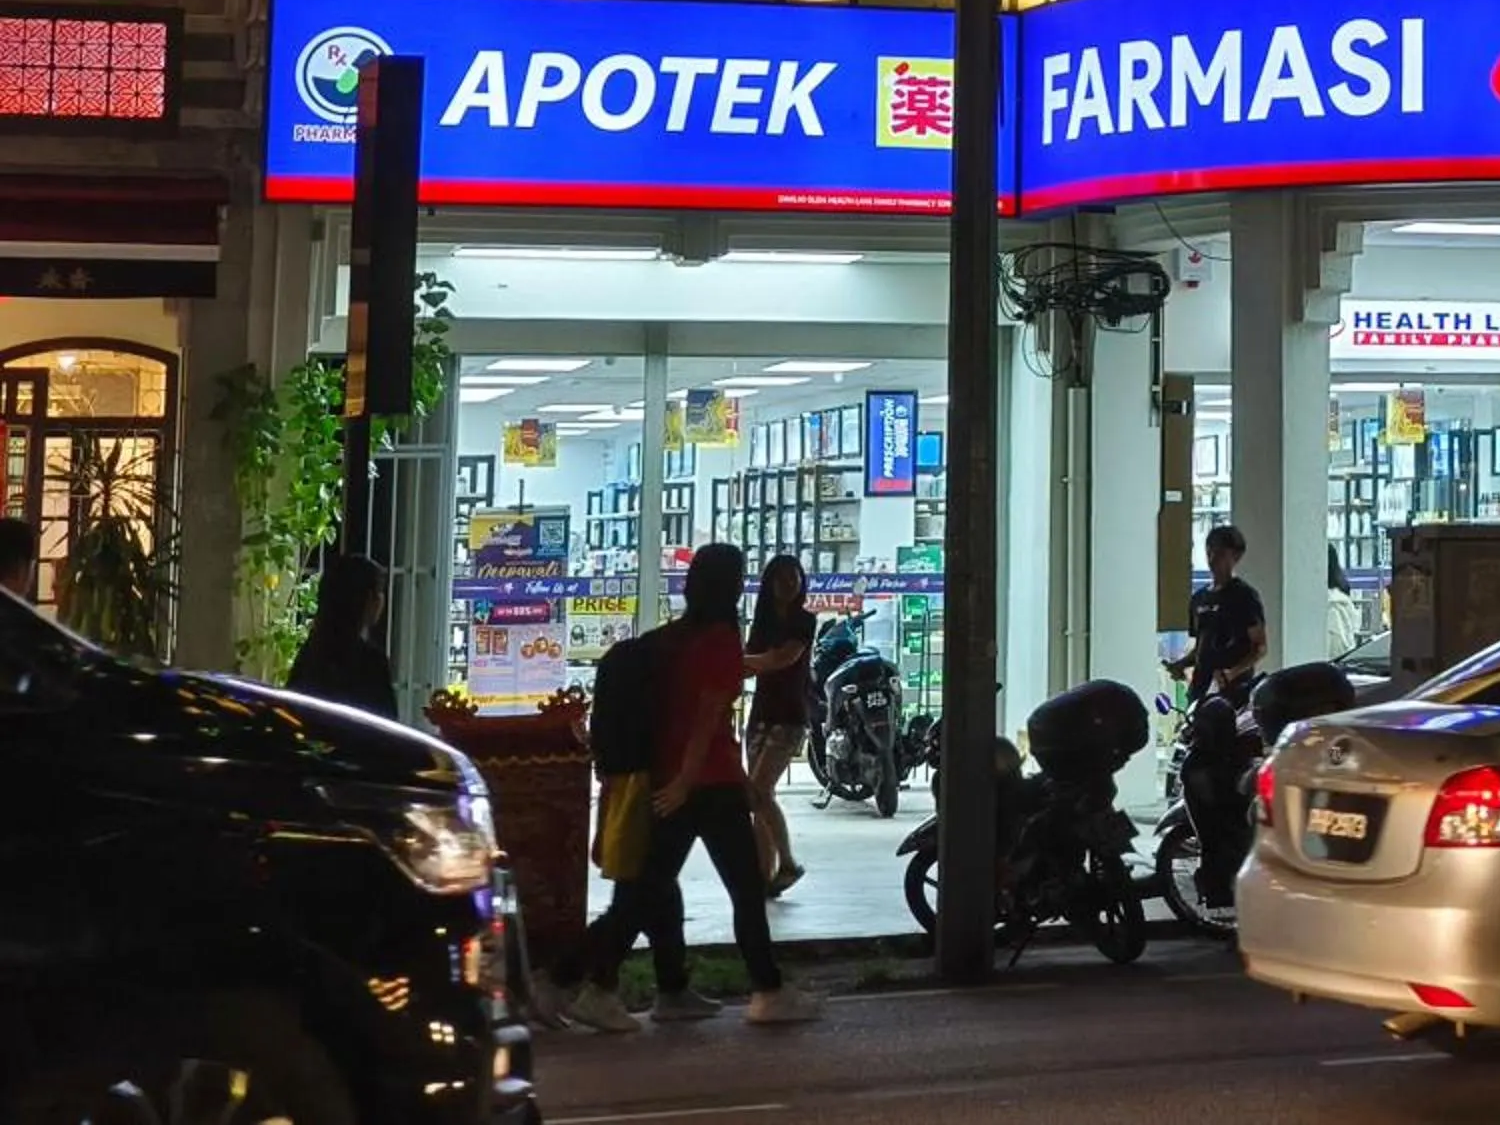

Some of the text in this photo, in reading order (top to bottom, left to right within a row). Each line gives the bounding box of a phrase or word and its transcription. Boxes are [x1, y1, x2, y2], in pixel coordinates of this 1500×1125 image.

[1041, 18, 1425, 145] FARMASI
[439, 50, 837, 136] APOTEK
[294, 125, 357, 142] PHARM
[1353, 311, 1472, 330] HEALTH
[1356, 333, 1433, 345] FAMILY
